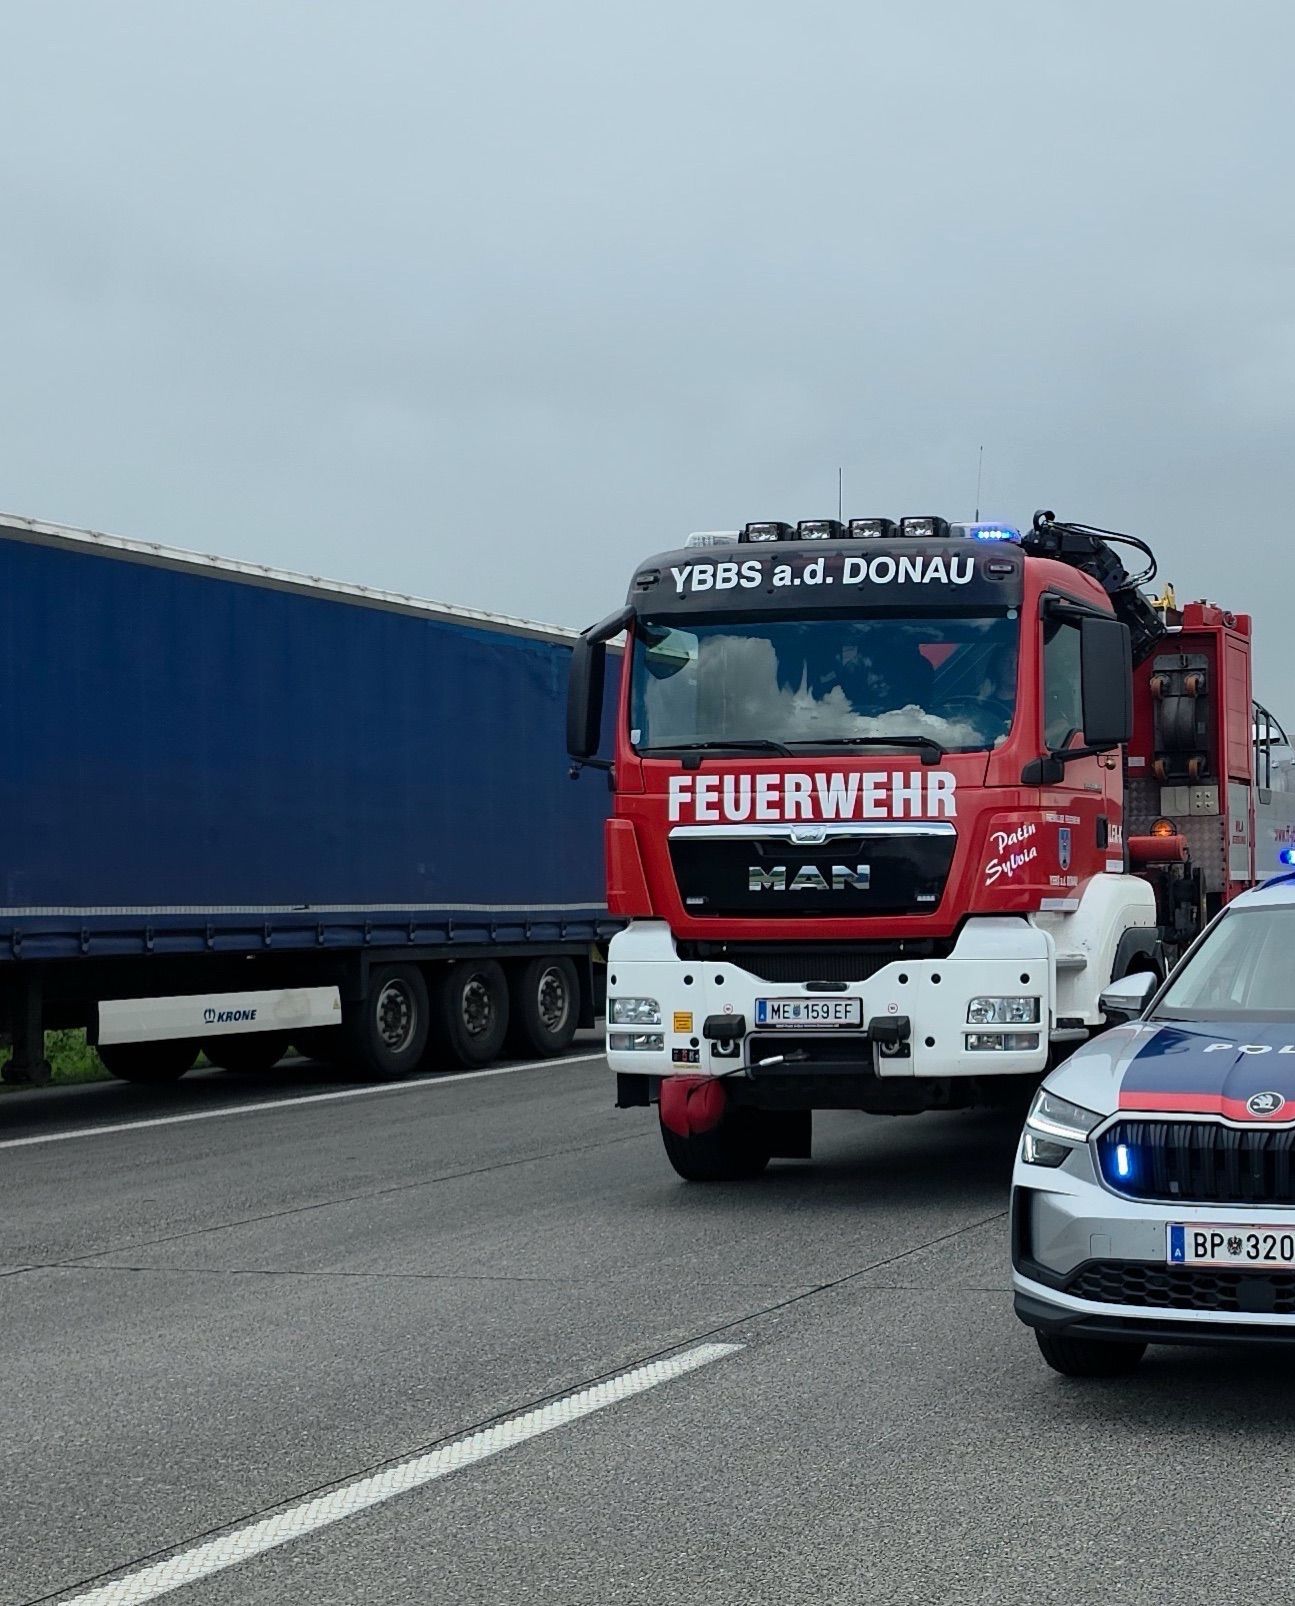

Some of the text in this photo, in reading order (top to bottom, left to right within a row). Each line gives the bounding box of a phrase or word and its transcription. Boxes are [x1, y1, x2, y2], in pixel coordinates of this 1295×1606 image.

[671, 556, 975, 593] YBBS a.d. DONAU
[668, 771, 958, 821] FEUERWEHR
[990, 823, 1036, 855] Patin
[748, 864, 871, 891] MAN
[985, 846, 1038, 886] Sylvia
[217, 1009, 257, 1023] KRONE
[771, 1003, 791, 1019] ME
[803, 1003, 830, 1020] 159
[834, 1003, 853, 1019] EF
[1174, 1247, 1182, 1257] A
[1194, 1232, 1225, 1259] BP
